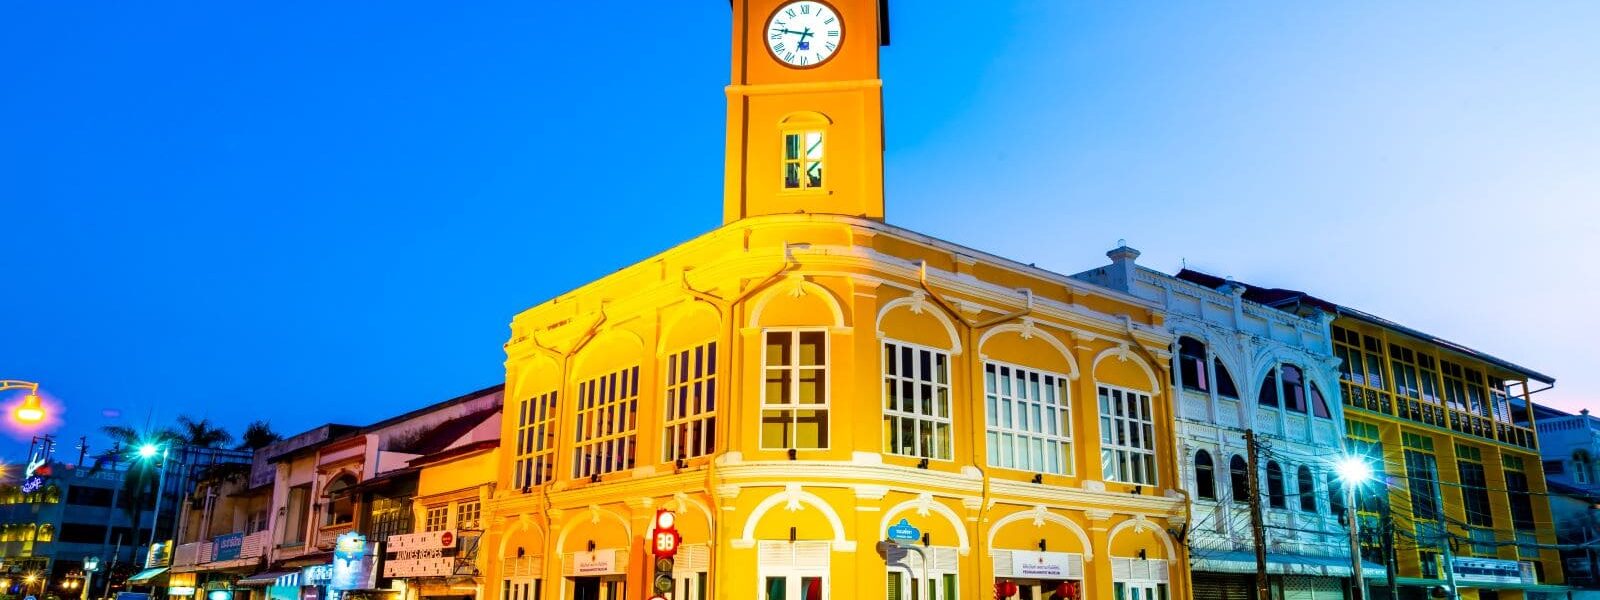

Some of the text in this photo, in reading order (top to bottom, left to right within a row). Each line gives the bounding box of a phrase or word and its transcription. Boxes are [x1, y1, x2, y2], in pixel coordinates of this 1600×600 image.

[785, 8, 797, 20] XI
[800, 4, 810, 15] XII
[774, 19, 786, 28] X
[824, 17, 834, 25] II
[773, 42, 786, 56] VIII
[825, 41, 836, 52] IV
[784, 51, 795, 63] VII
[800, 56, 809, 66] VI
[816, 52, 824, 62] V
[657, 533, 674, 551] 38
